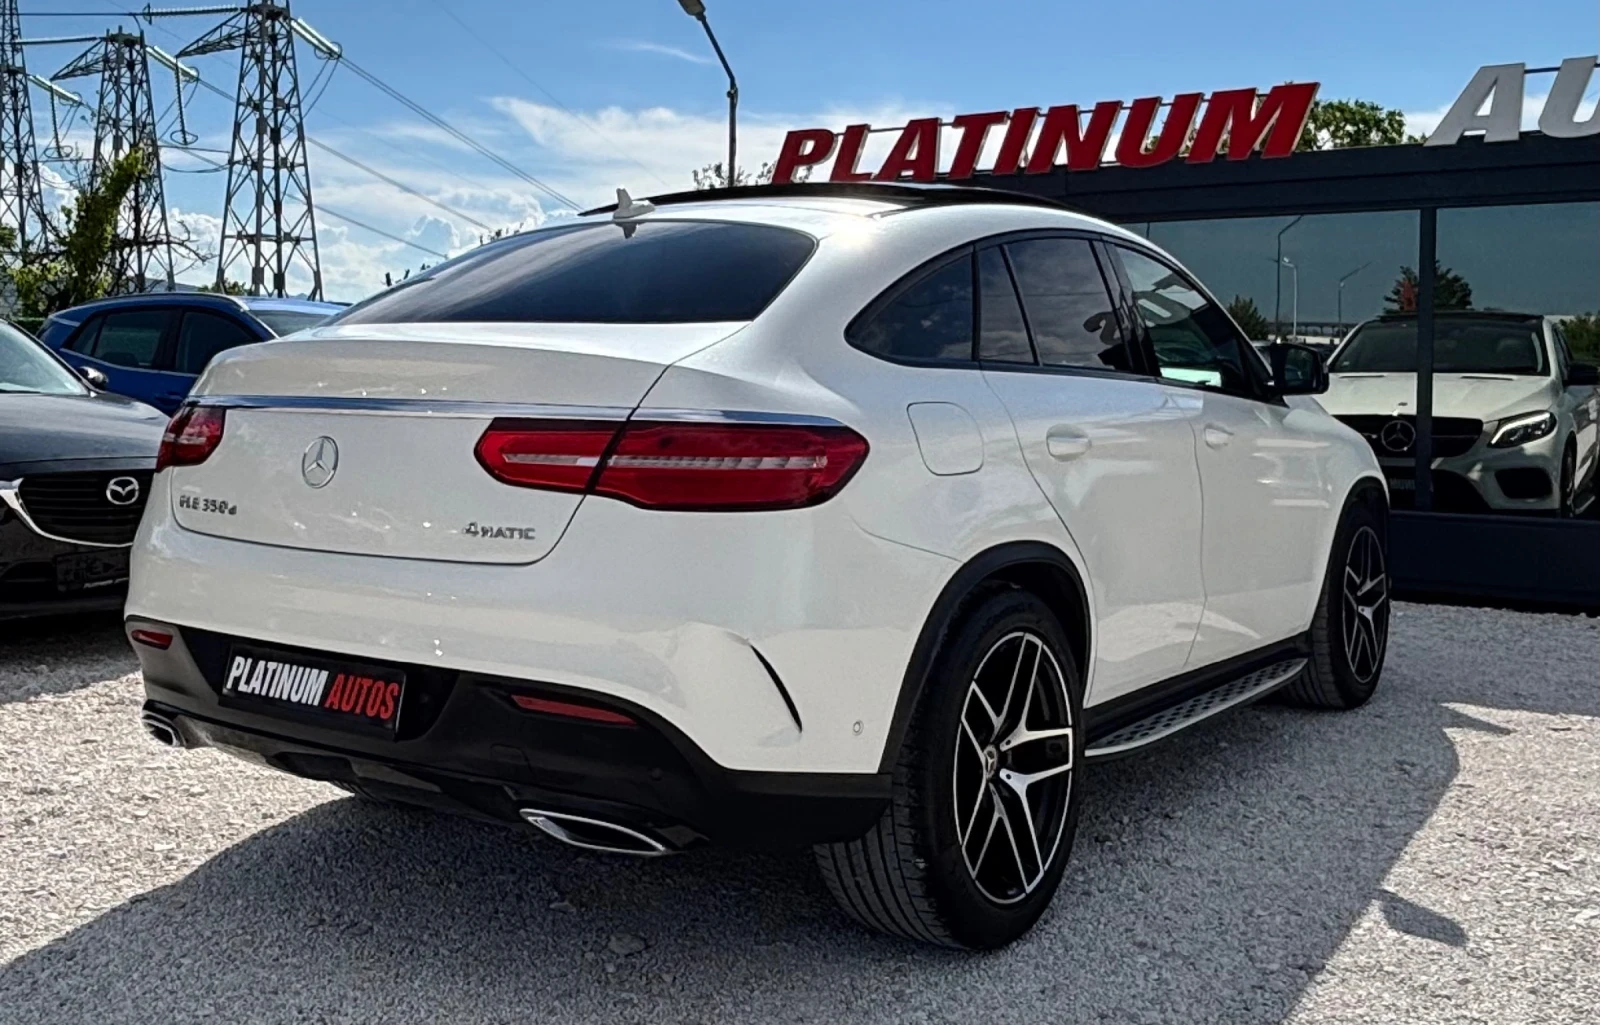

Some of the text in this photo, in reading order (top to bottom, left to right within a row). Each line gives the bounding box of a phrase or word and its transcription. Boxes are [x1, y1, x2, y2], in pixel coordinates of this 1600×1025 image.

[771, 82, 1321, 185] PLATINUM
[462, 521, 536, 541] 4MATIC
[226, 656, 399, 720] PLATINUM AUTOS
